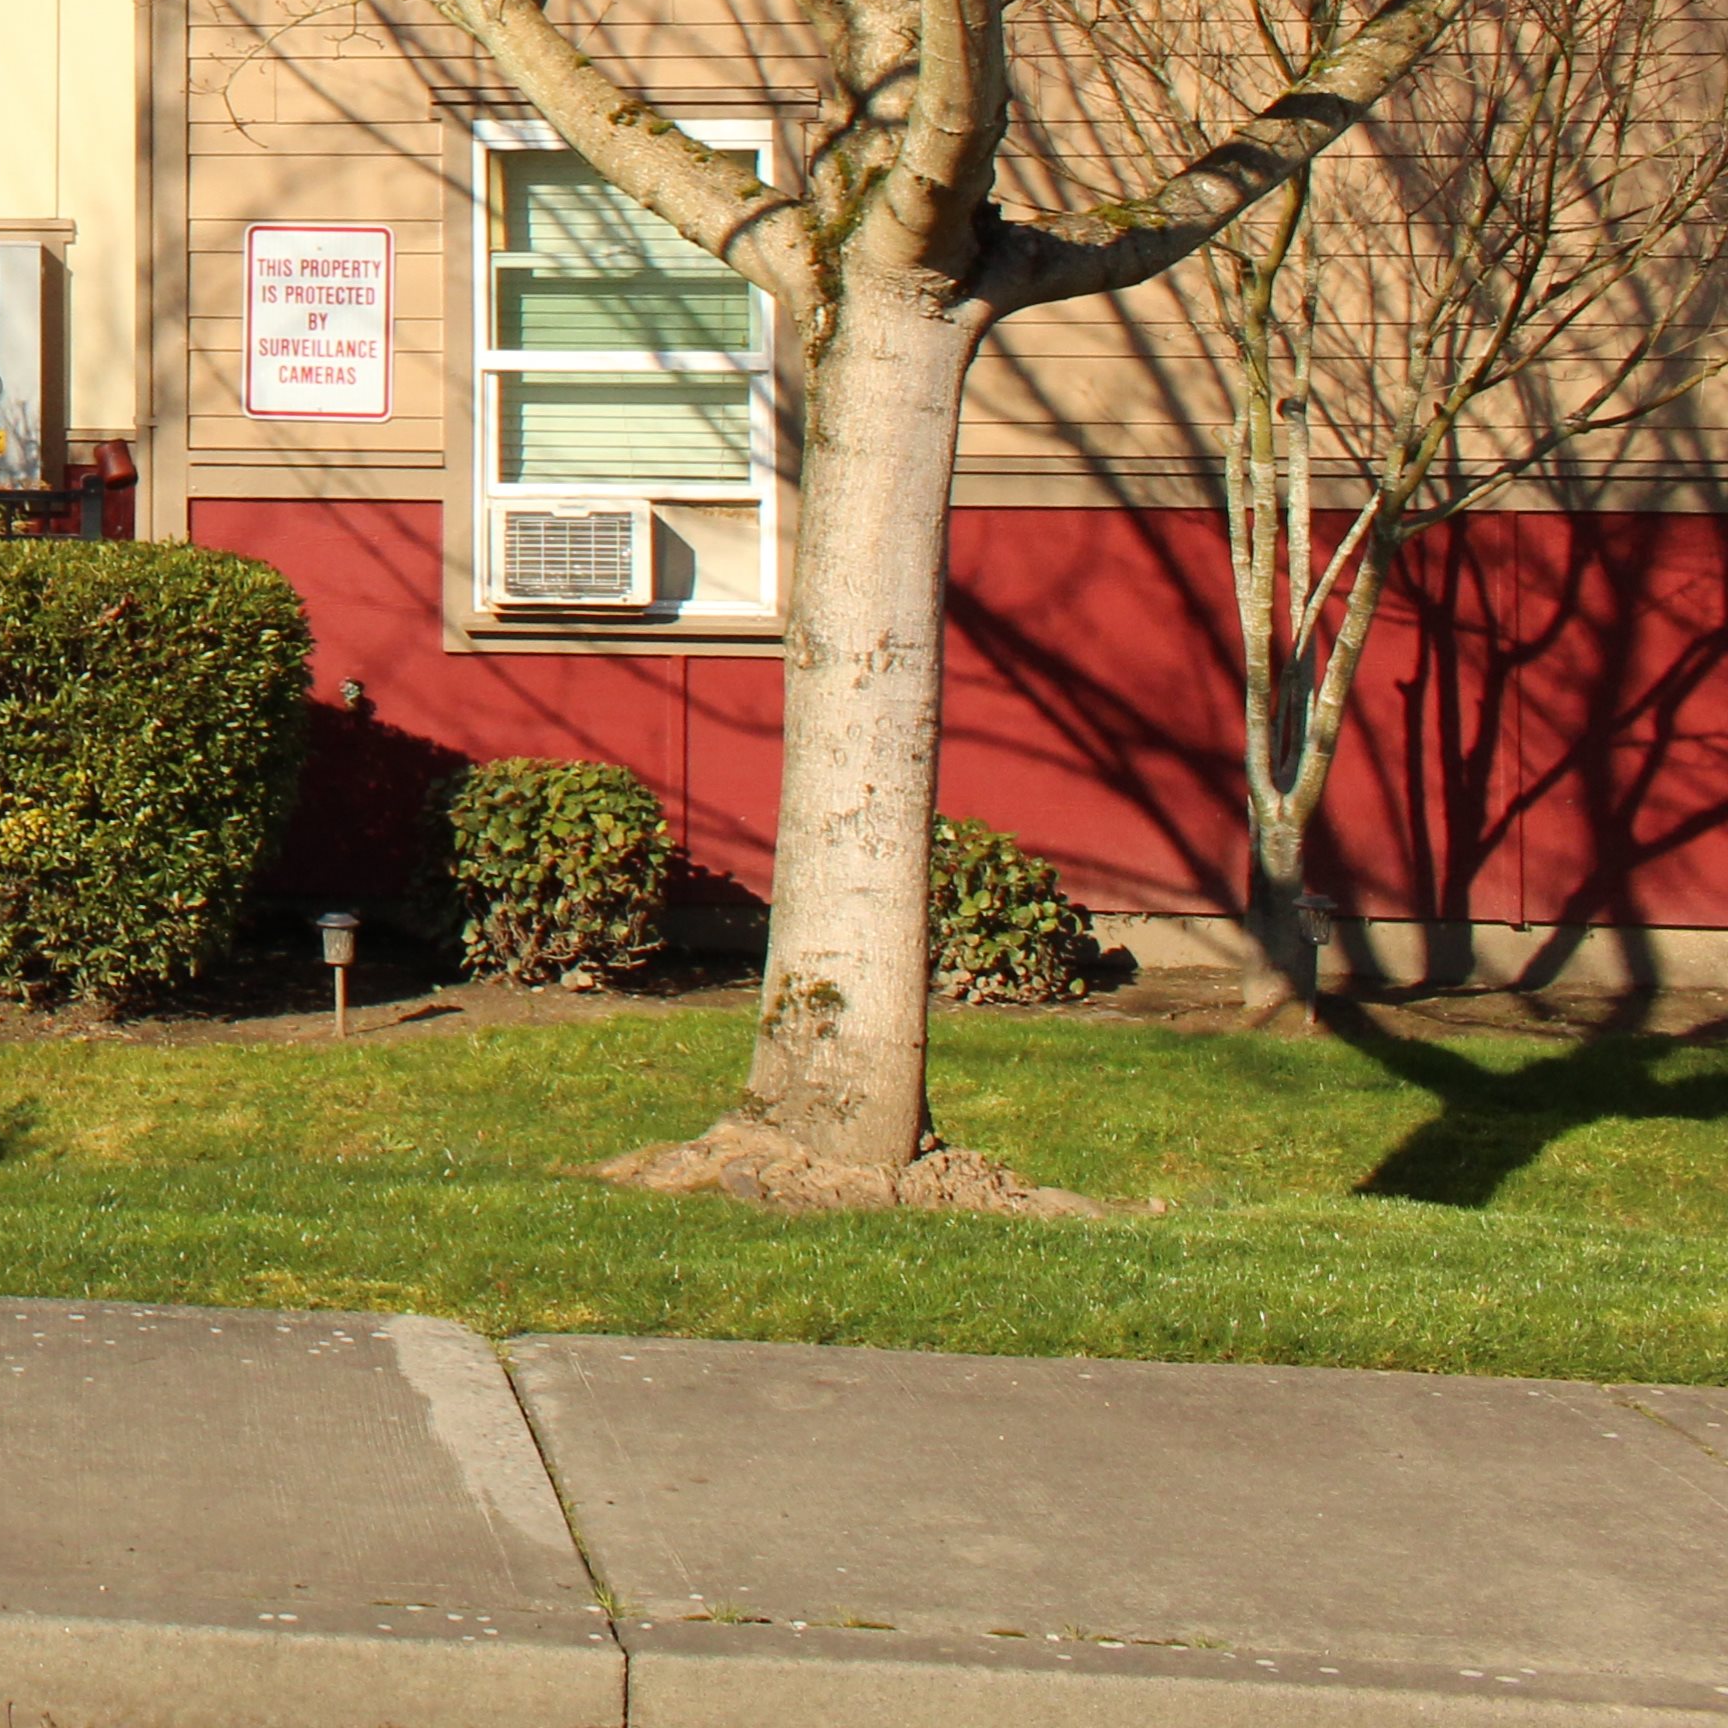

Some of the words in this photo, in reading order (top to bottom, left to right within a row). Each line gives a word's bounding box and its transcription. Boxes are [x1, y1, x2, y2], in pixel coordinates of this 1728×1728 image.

[257, 258, 293, 277] THIS
[300, 259, 382, 279] PROPERTY
[262, 285, 277, 303] IS
[285, 285, 375, 305] PROTECTED
[308, 312, 328, 331] BY
[259, 338, 377, 358] SURVEILLANCE
[279, 365, 356, 385] CAMERAS
